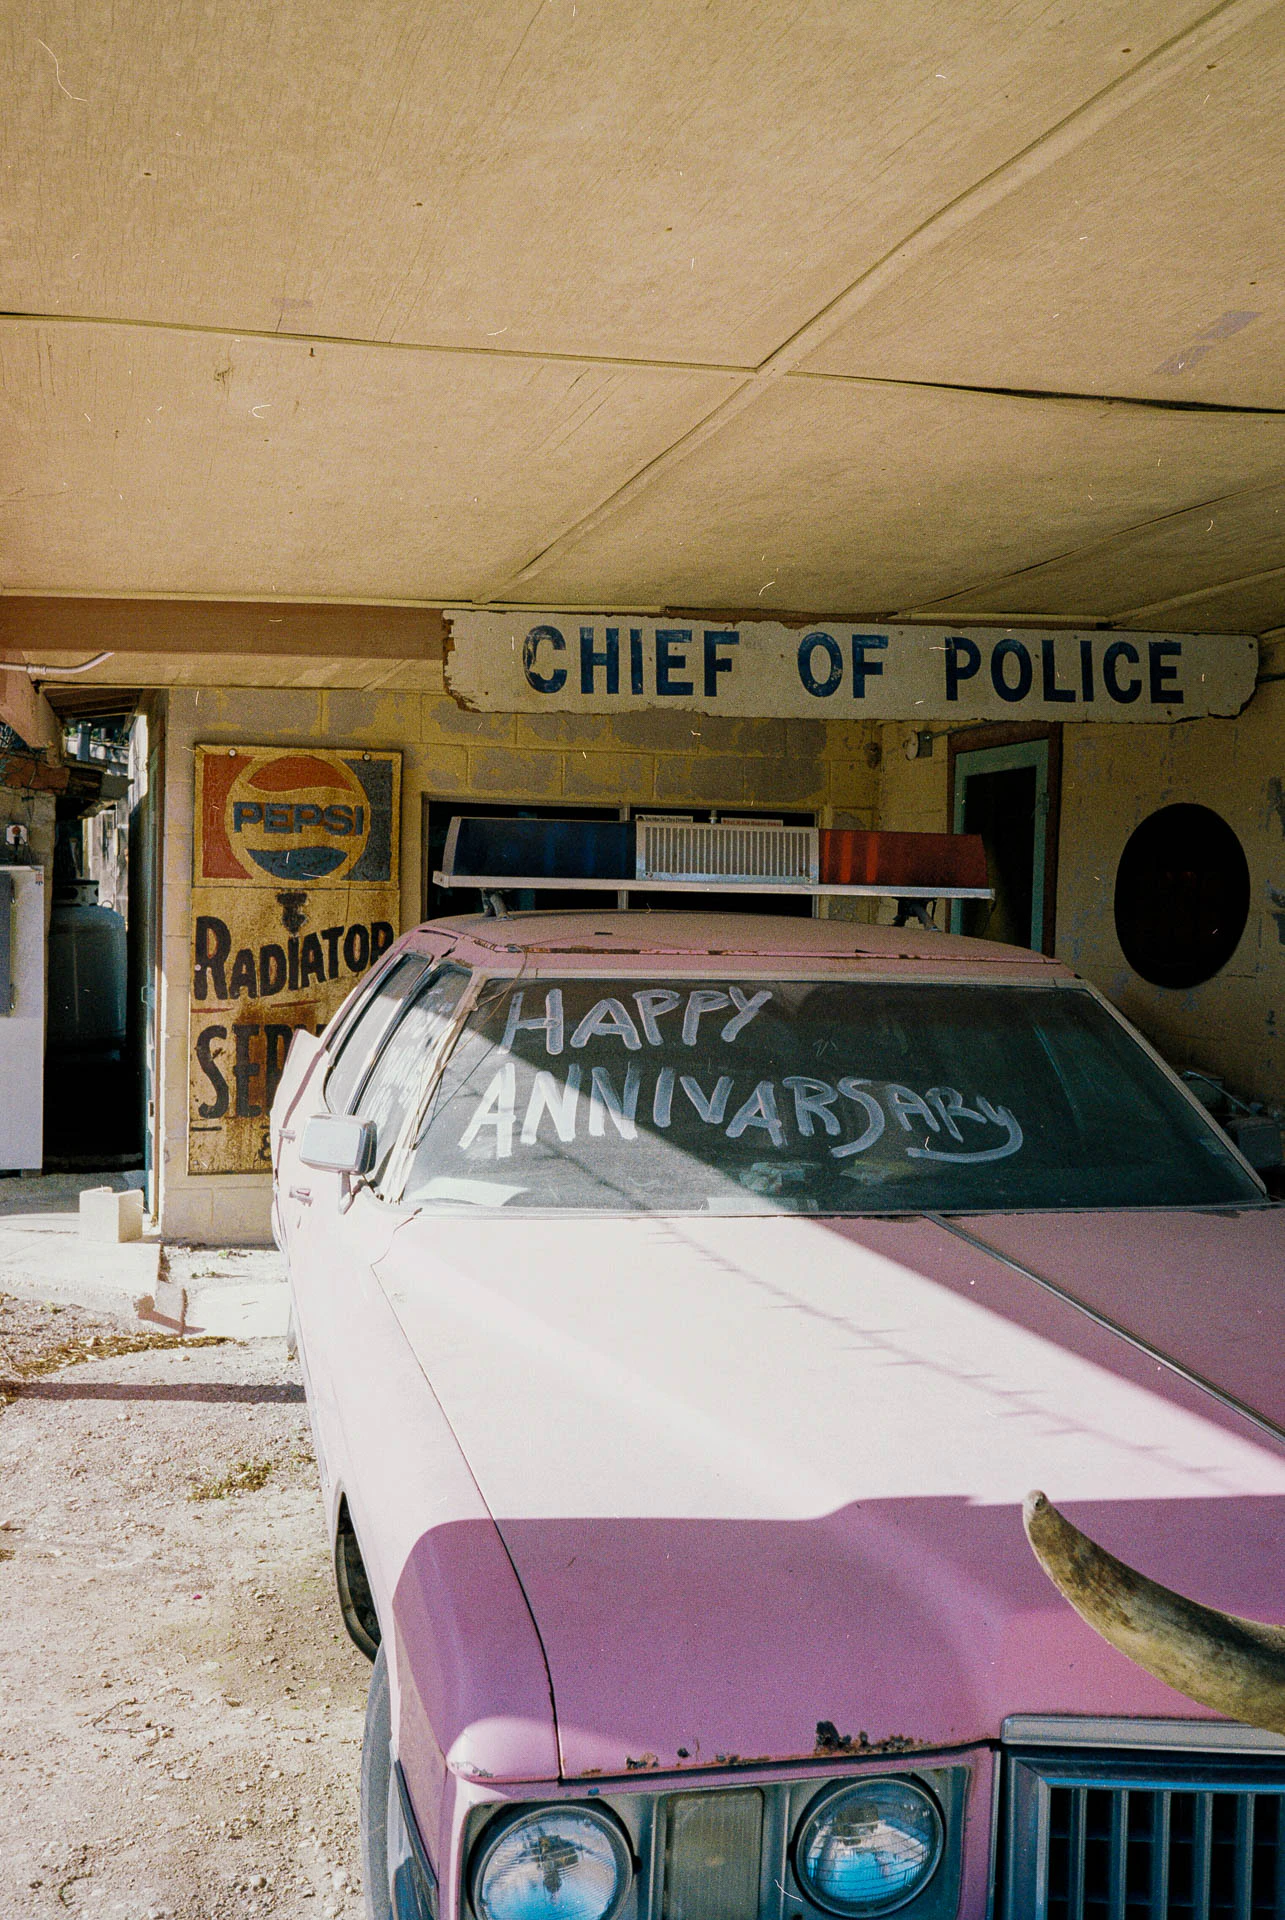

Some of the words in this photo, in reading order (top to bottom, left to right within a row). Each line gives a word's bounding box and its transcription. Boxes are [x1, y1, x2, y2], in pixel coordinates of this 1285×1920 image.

[523, 626, 740, 697] CHIEF
[798, 632, 889, 698] OF
[945, 637, 1184, 704] POLICE
[233, 802, 364, 836] PEPSI
[498, 988, 772, 1054] HAPPY
